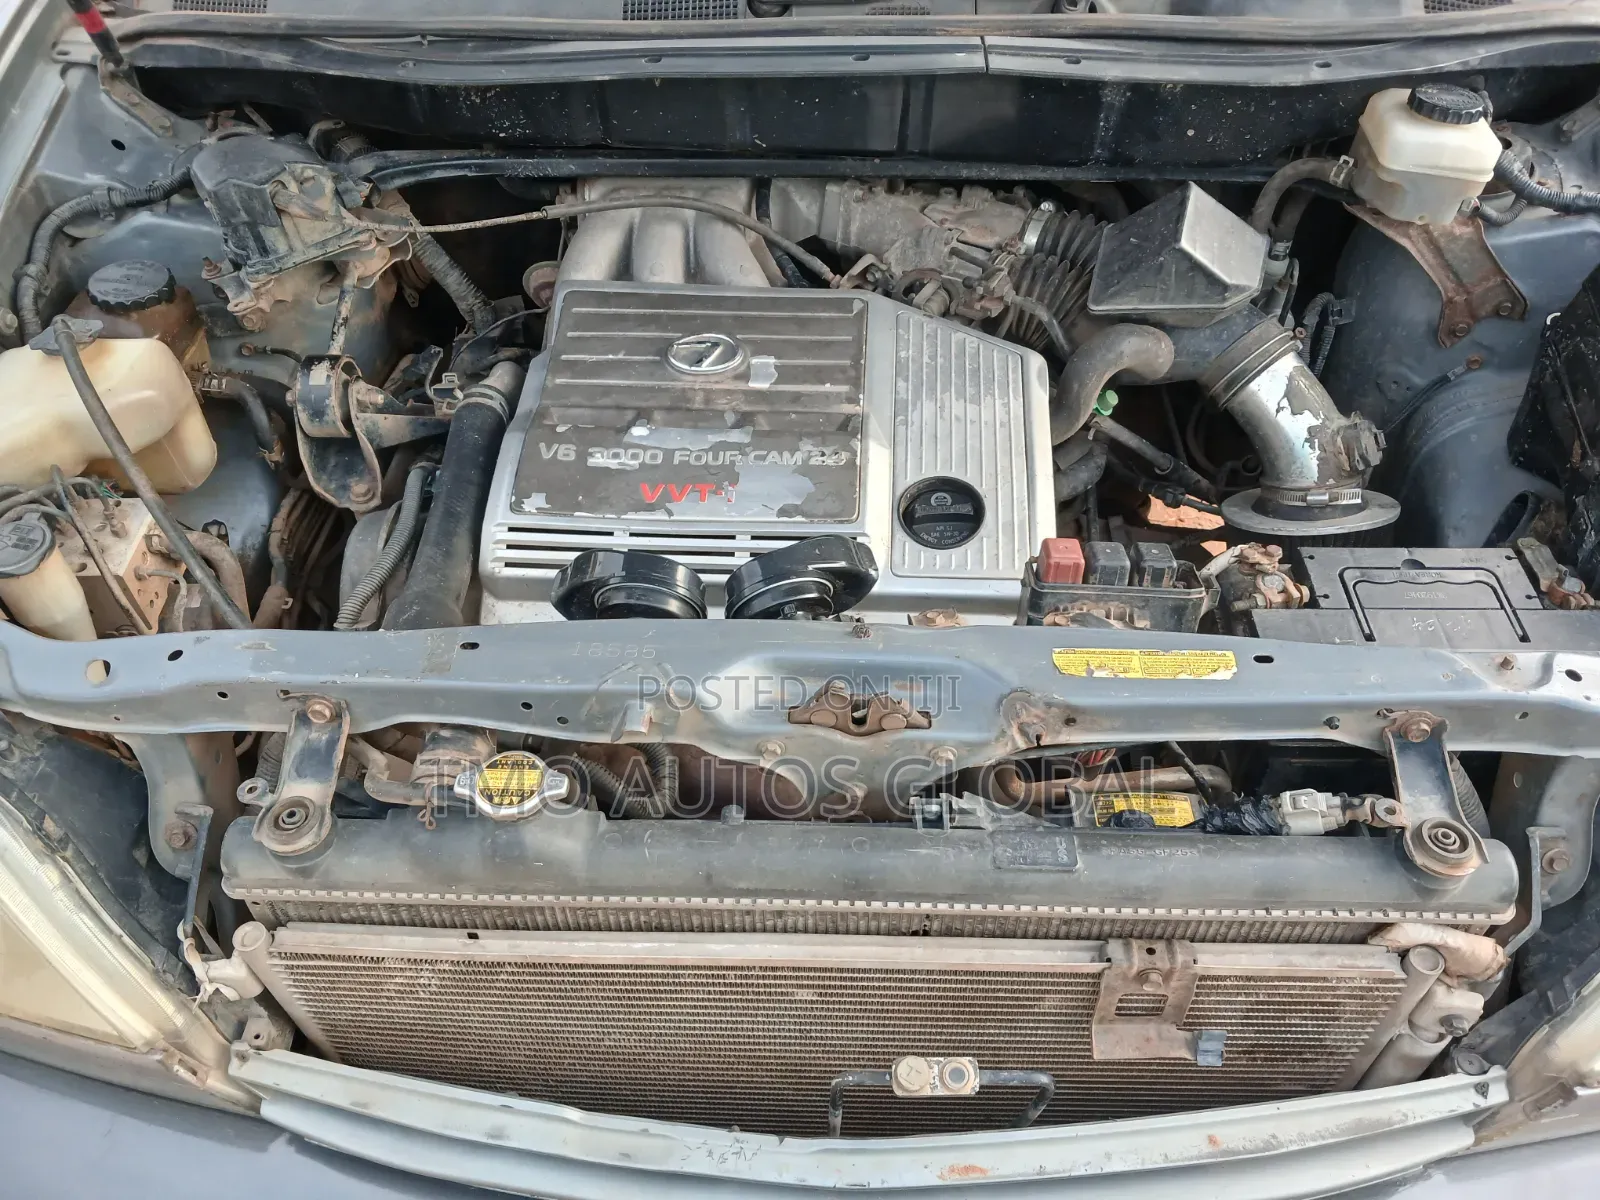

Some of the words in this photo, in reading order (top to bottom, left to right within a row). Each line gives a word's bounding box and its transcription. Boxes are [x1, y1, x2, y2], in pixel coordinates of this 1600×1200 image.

[538, 442, 577, 461] V6
[588, 447, 663, 466] 3000
[673, 449, 742, 466] FOUR
[748, 449, 801, 466] CAM
[484, 788, 531, 796] CAUTION
